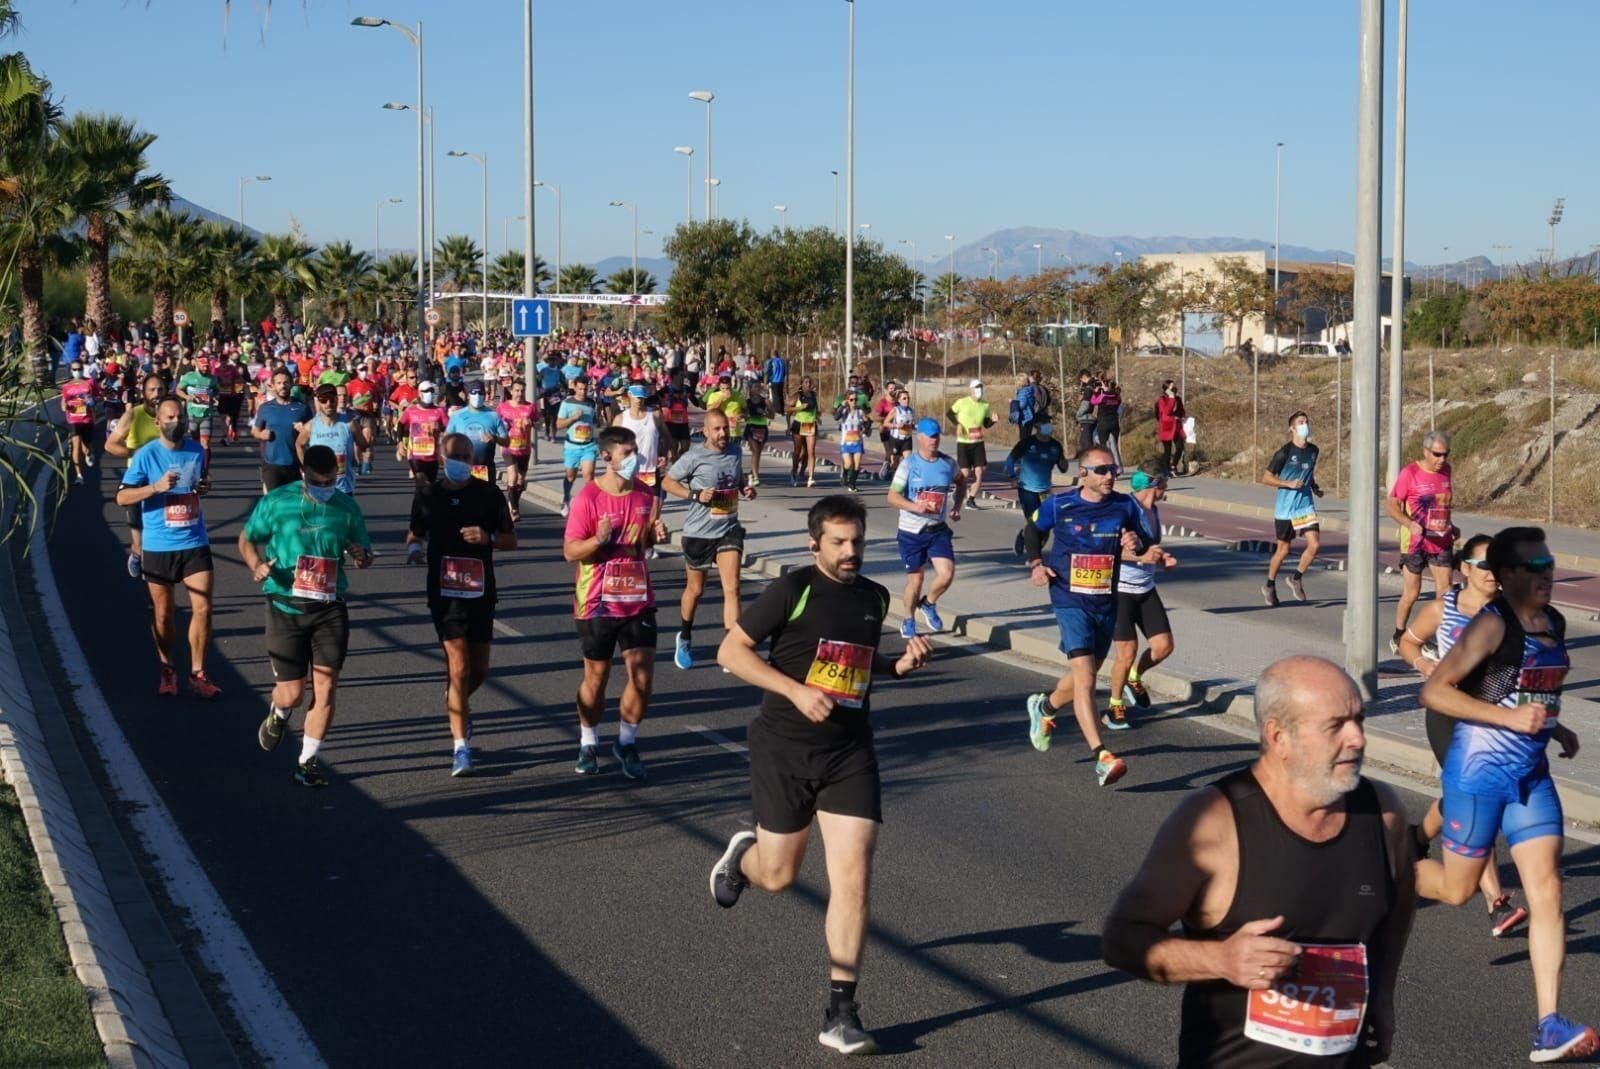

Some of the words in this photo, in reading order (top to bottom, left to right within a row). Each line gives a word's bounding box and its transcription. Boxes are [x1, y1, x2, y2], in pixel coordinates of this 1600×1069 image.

[428, 313, 438, 321] 50
[299, 570, 327, 584] 4711
[1075, 569, 1102, 579] 6275
[606, 577, 635, 587] 4712
